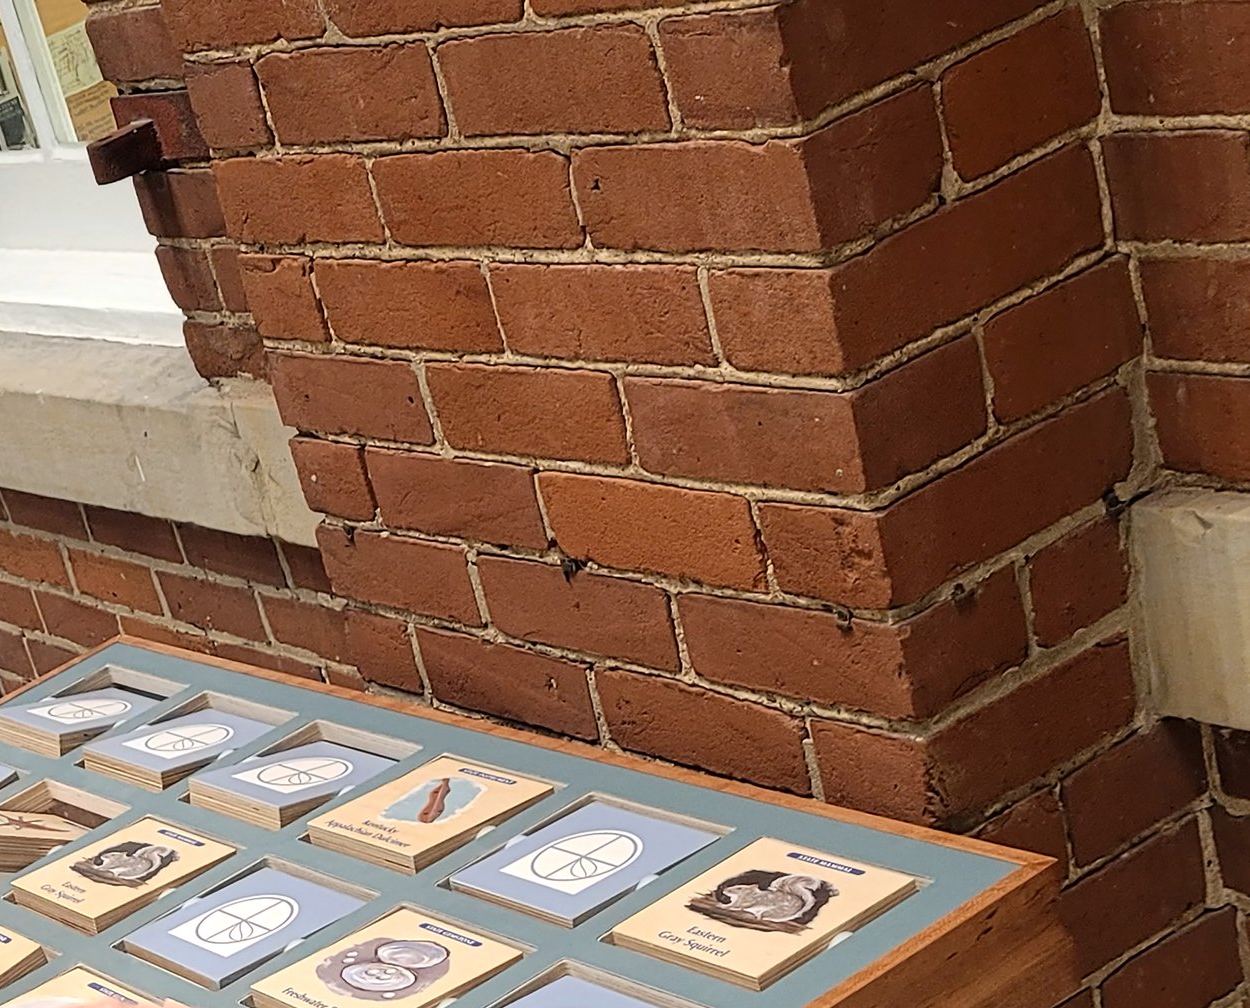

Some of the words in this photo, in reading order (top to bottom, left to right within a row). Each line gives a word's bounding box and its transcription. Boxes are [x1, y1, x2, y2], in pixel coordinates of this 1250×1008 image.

[658, 930, 685, 944] Gray
[683, 938, 731, 957] Squirrel
[686, 926, 727, 944] Eastern
[282, 987, 329, 1008] Freshwater
